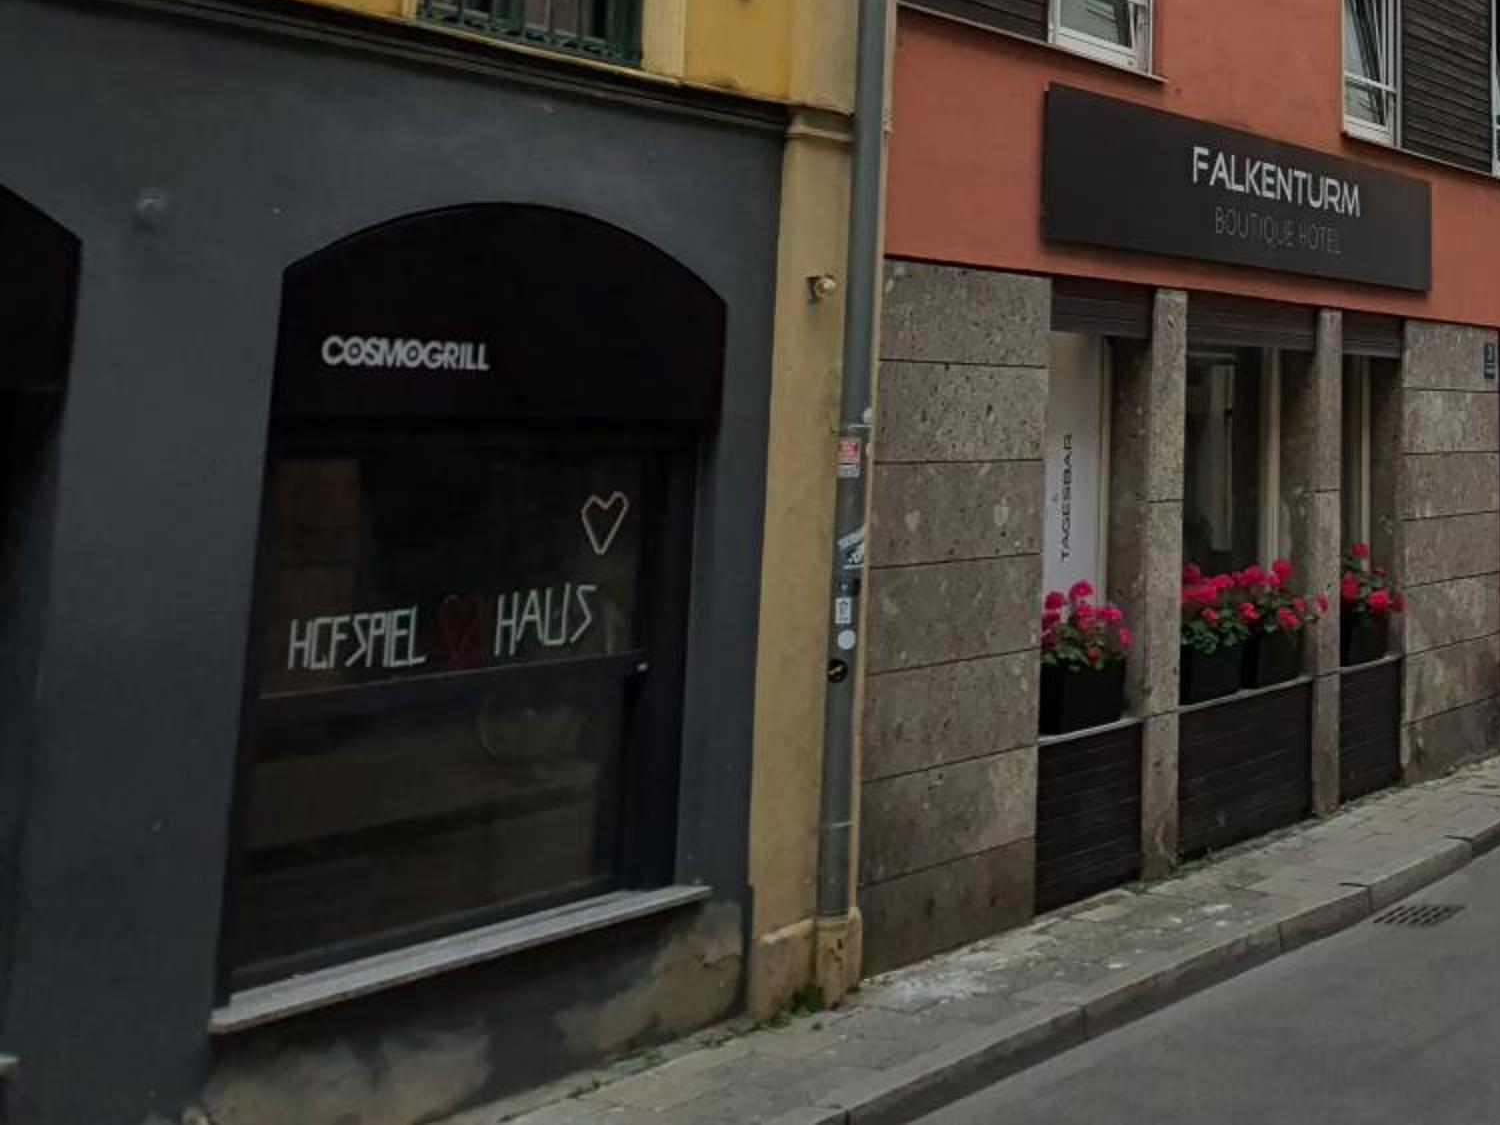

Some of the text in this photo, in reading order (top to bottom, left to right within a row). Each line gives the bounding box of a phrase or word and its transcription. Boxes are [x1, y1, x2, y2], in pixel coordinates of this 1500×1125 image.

[1192, 145, 1361, 218] FALKENTURM
[1215, 205, 1343, 255] BOUTIQUE HOTEL
[320, 333, 491, 373] COSMOGRILL
[493, 581, 597, 657] HAUS
